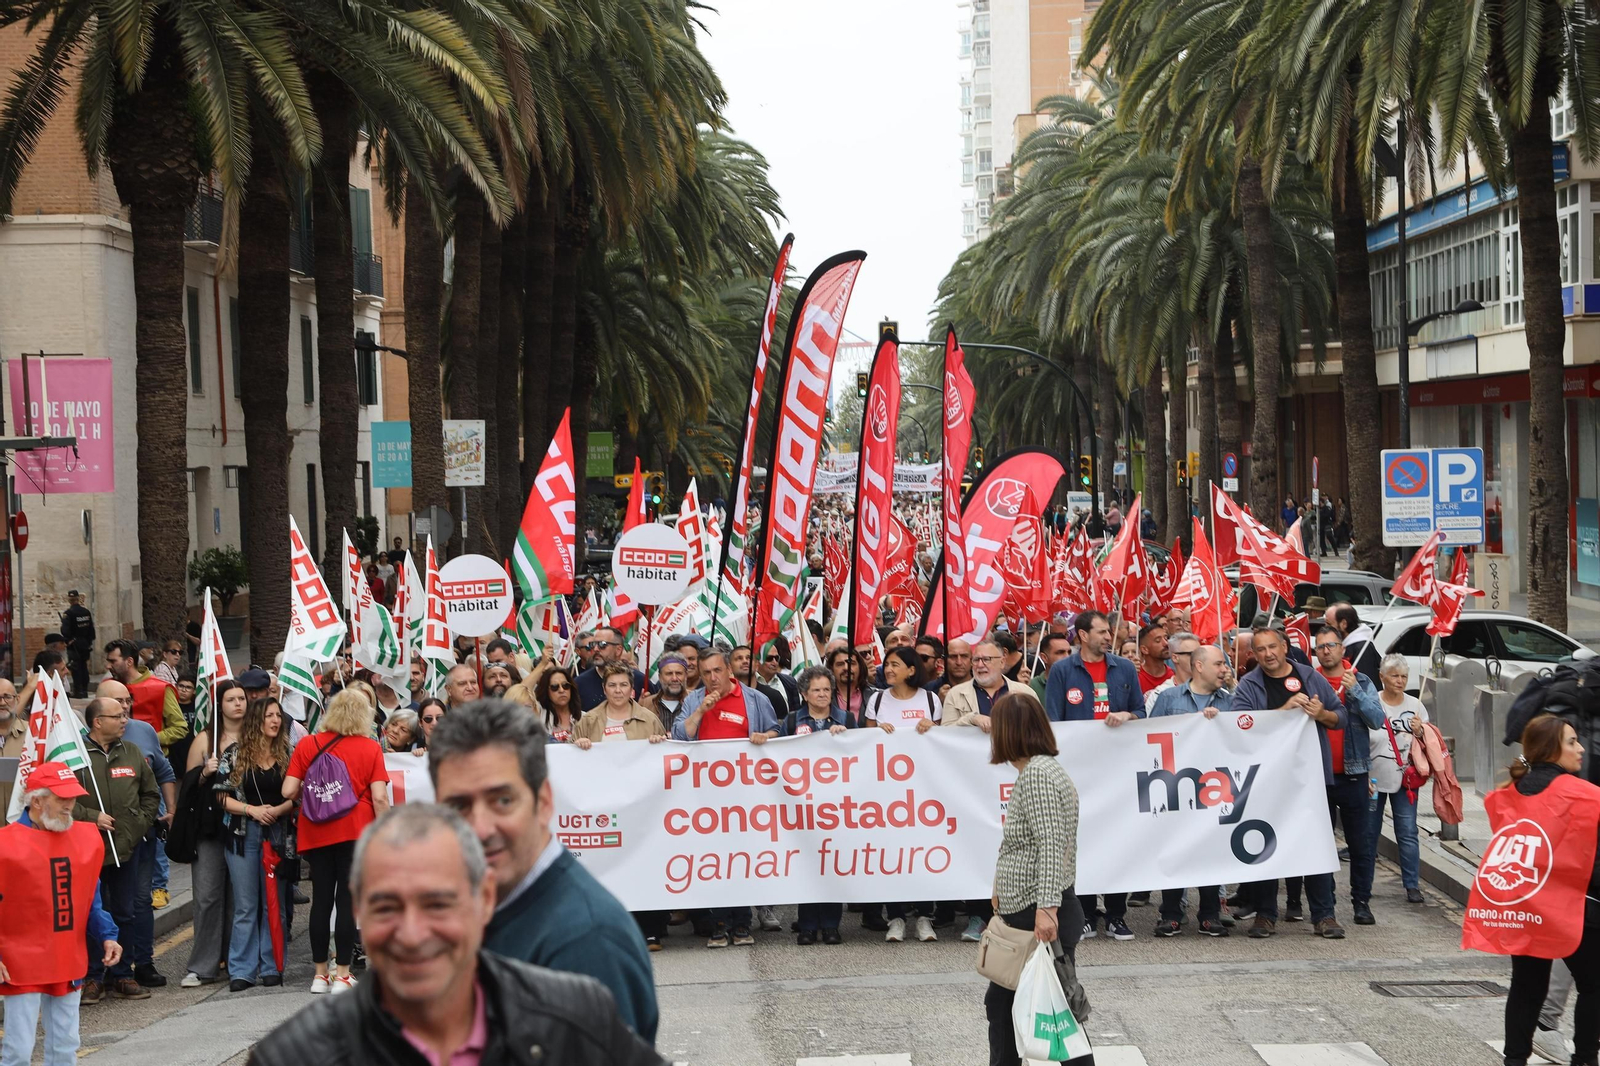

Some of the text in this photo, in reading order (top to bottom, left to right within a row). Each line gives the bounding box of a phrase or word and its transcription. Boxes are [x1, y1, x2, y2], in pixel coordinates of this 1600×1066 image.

[833, 264, 858, 321] MÁLAGA
[23, 401, 38, 418] 0
[64, 401, 101, 417] MAYO
[80, 423, 87, 439] 1
[93, 423, 101, 439] H
[377, 442, 411, 451] 10 DE MAY
[377, 452, 386, 461] DE
[387, 452, 396, 461] 20
[398, 452, 403, 461] A
[1438, 453, 1477, 502] P
[859, 446, 887, 599] UGT
[553, 535, 573, 581] málaga
[622, 551, 666, 564] CCOO
[627, 567, 677, 581] hábitat
[442, 583, 486, 596] CCOO
[448, 598, 499, 613] hábitat
[667, 601, 699, 632] Málaga
[902, 710, 917, 718] UGT
[1147, 732, 1175, 775] 1
[664, 744, 915, 796] Proteger lo
[559, 815, 593, 828] UGT
[664, 790, 957, 842] conquistado,
[1136, 763, 1278, 865] mayo
[559, 835, 601, 846] CCOO
[1486, 834, 1542, 868] UGT
[664, 838, 951, 894] ganar futuro
[54, 862, 70, 927] CCOO
[1469, 908, 1498, 920] mano
[1503, 910, 1543, 925] mano
